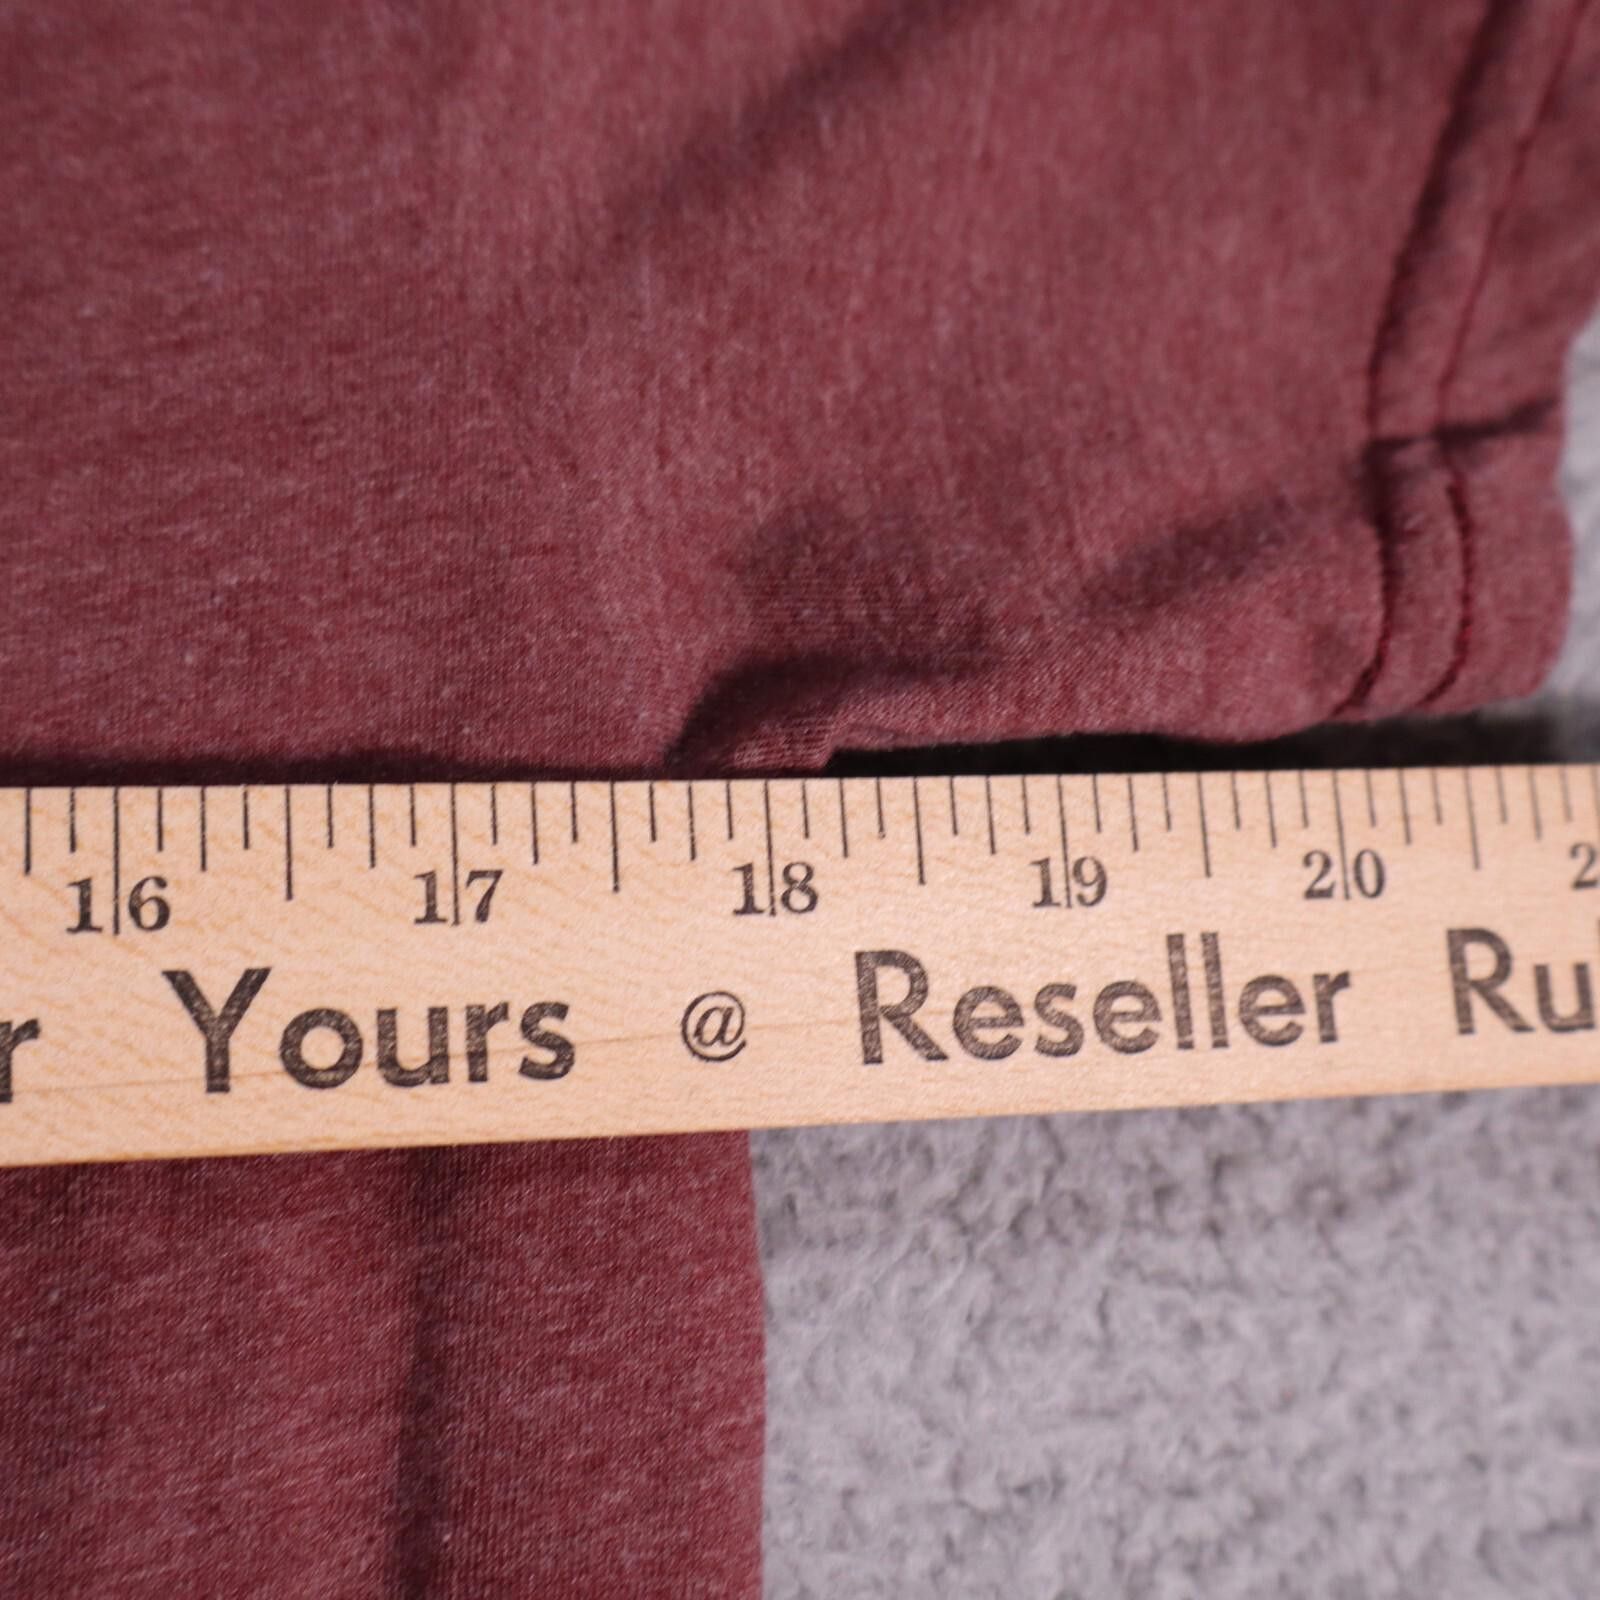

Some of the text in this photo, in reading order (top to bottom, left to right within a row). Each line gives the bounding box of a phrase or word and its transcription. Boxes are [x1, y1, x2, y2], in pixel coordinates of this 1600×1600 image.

[67, 876, 171, 934] 16
[413, 870, 503, 925] 17
[734, 862, 819, 916] 18
[1032, 857, 1108, 908] 19
[1303, 849, 1387, 901] 20
[162, 966, 577, 1094] Yours
[681, 991, 748, 1062] @
[854, 931, 1351, 1065] Reseller
[1447, 920, 1600, 1036] Ru
